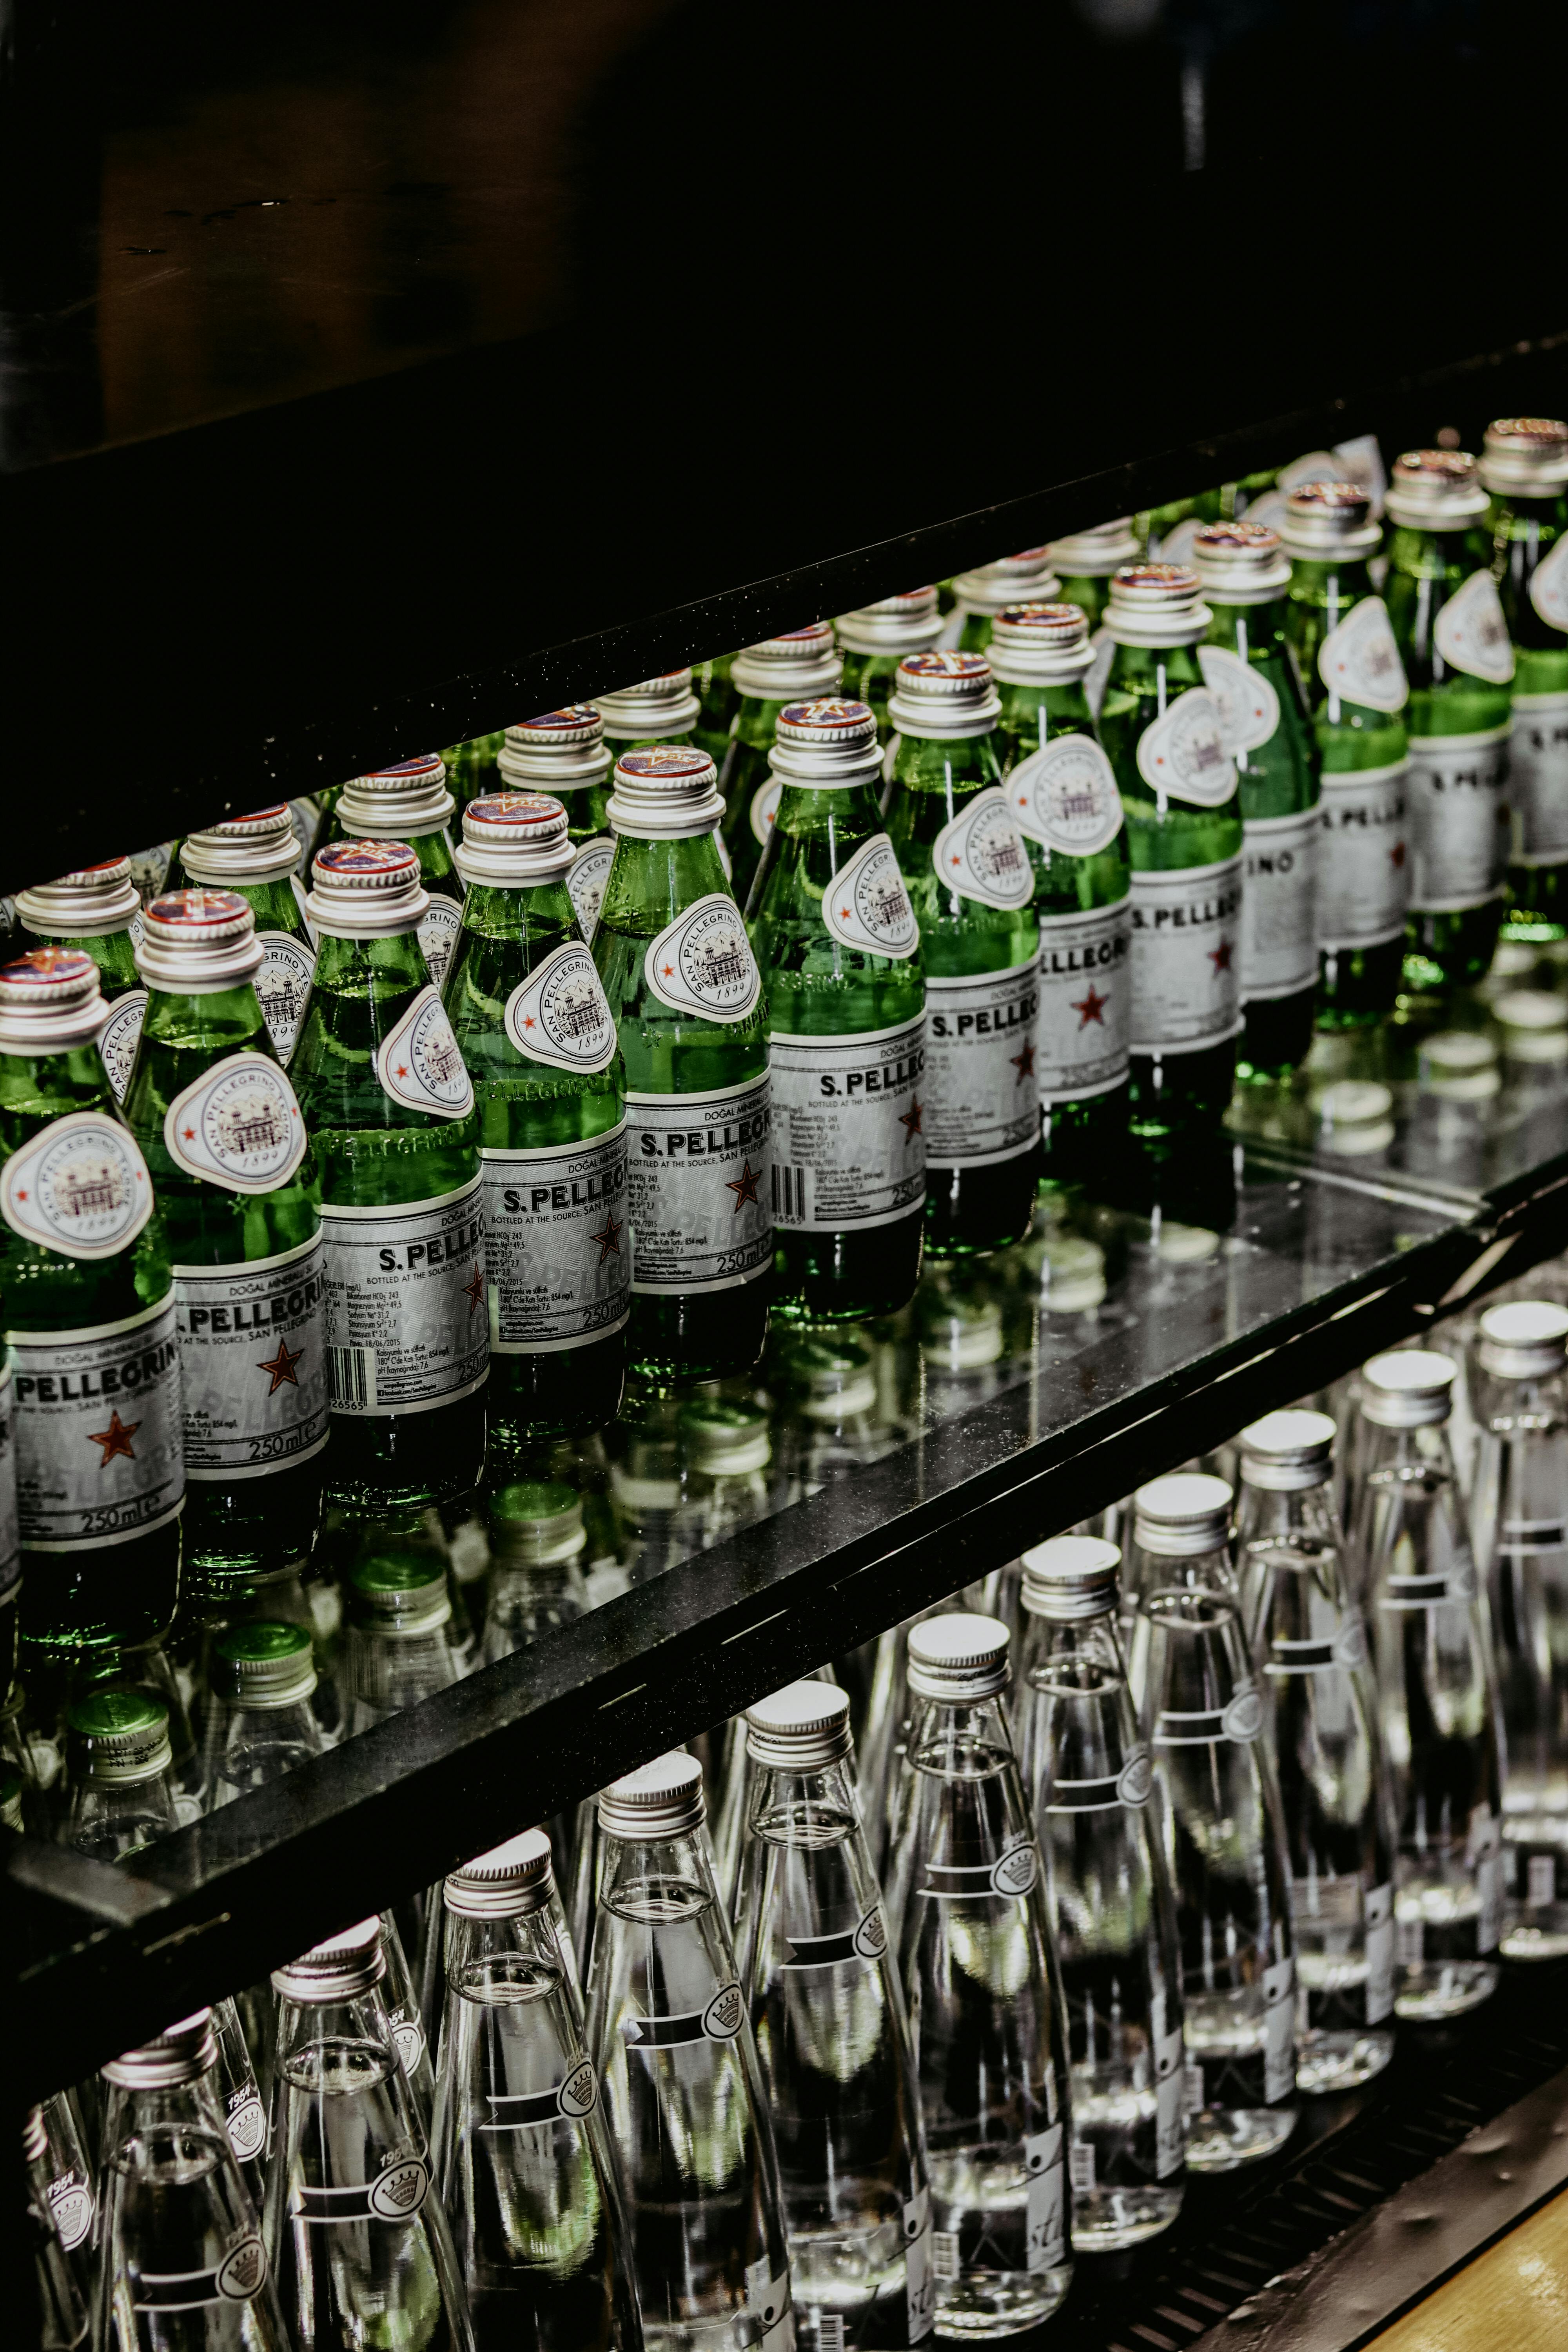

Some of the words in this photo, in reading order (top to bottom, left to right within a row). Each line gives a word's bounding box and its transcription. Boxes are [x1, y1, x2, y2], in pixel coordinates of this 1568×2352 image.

[863, 906, 879, 931] SAN
[684, 914, 737, 958] PELLEGRINO
[544, 961, 594, 1008] PELLEGRINO
[686, 965, 704, 991] SAN
[717, 983, 744, 1000] 1899
[106, 1011, 144, 1059] PELLEGR
[547, 1015, 566, 1043] SAN
[578, 1031, 603, 1051] 1899
[419, 1063, 437, 1089] SAN
[705, 1109, 735, 1121] DOĞAL
[568, 1160, 598, 1173] DOĞAL
[629, 1159, 658, 1168] BOTTLED
[720, 1151, 737, 1163] SAN
[442, 1210, 466, 1226] DOĞAL
[553, 1211, 582, 1221] SOURCE,
[584, 1202, 601, 1215] SAN
[367, 1276, 399, 1284] BOTTLED
[456, 1254, 471, 1267] SAN
[490, 1278, 523, 1286] 18/06/2015
[562, 1290, 573, 1301] mg/L
[348, 1302, 375, 1310] Magnezyum
[390, 1301, 402, 1309] 49,5
[501, 1305, 508, 1313] pH
[348, 1310, 366, 1319] Sodyum
[377, 1311, 390, 1319] 31,2
[388, 1320, 397, 1328] 2,7
[249, 1329, 271, 1341] SAN
[366, 1338, 401, 1348] 18/06/2015
[404, 1355, 414, 1363] Katı
[415, 1352, 428, 1362] Tortu:
[429, 1348, 438, 1359] 854
[378, 1366, 386, 1375] pH
[387, 1363, 419, 1374] (kaynağında):
[420, 1361, 428, 1370] 7,6
[228, 2083, 250, 2110] 1954
[47, 2170, 74, 2198] 1954
